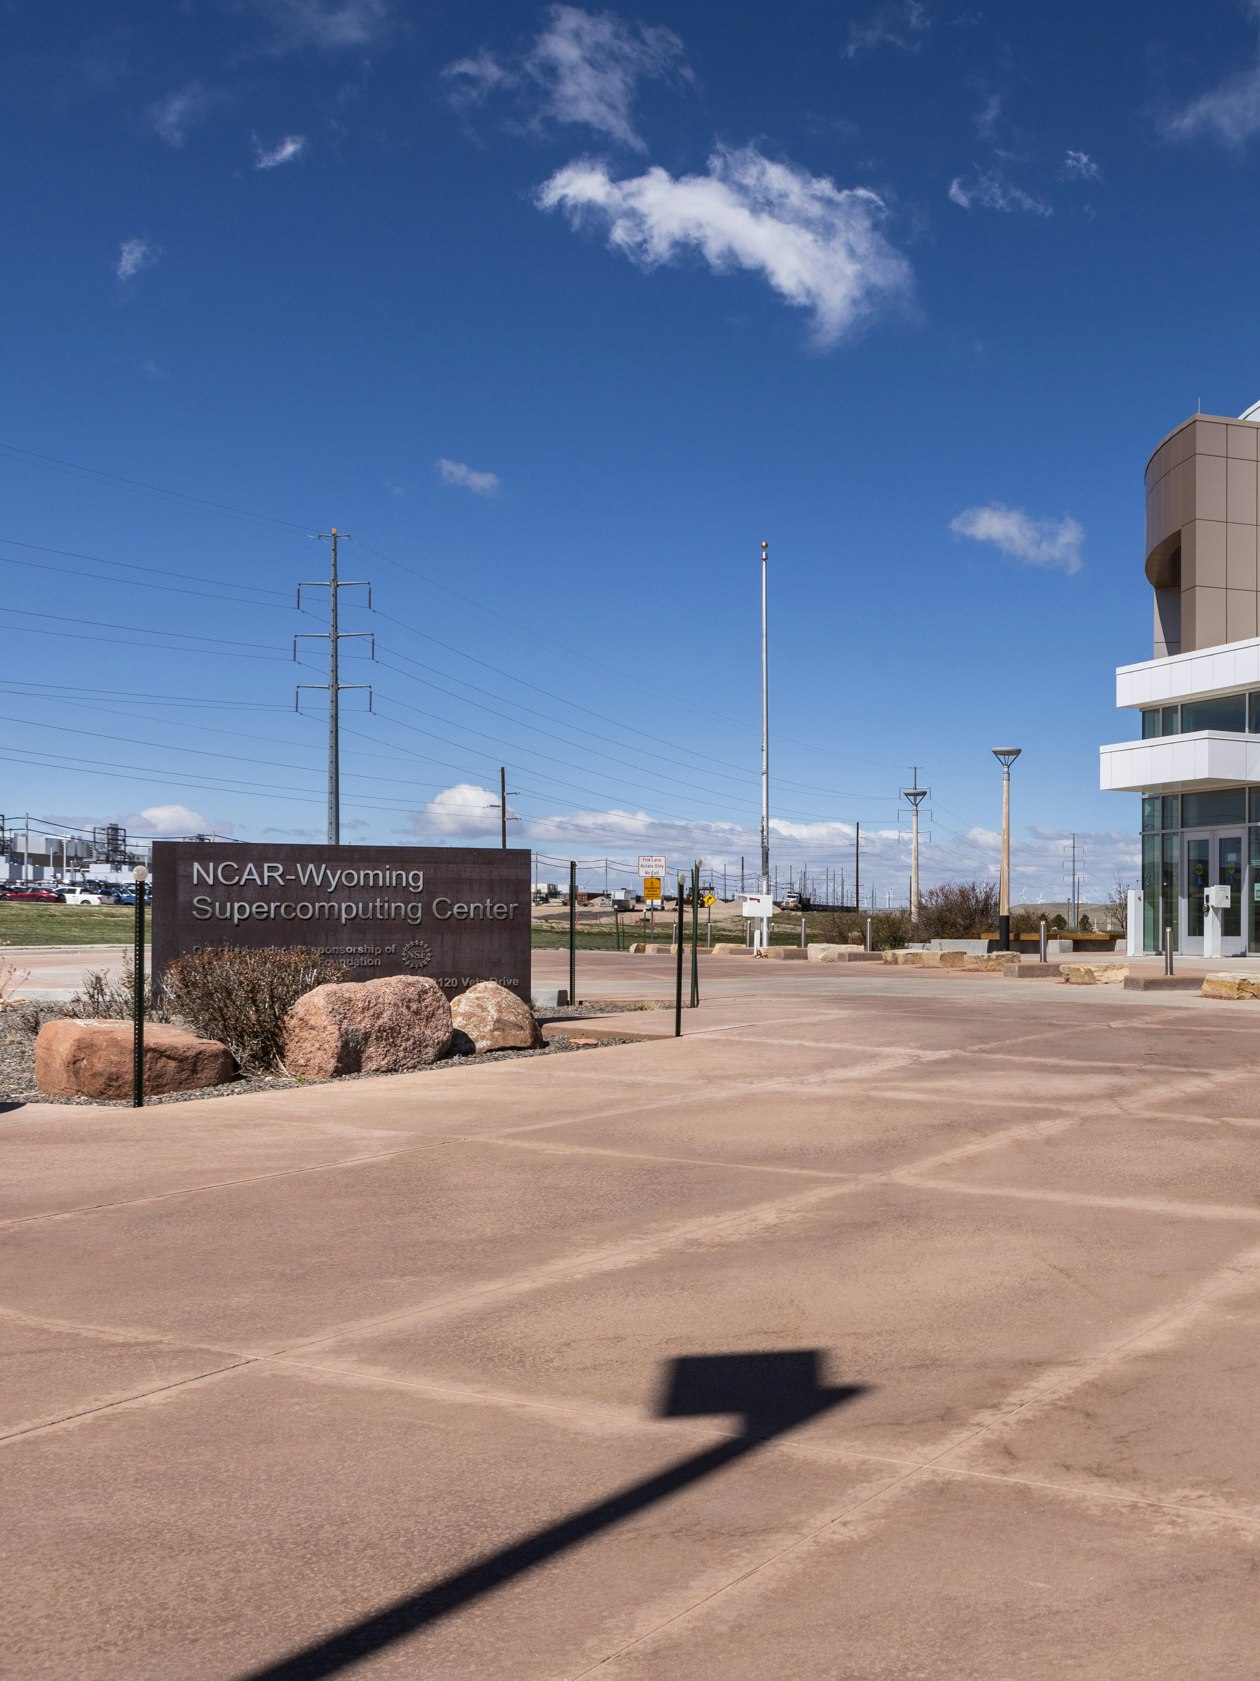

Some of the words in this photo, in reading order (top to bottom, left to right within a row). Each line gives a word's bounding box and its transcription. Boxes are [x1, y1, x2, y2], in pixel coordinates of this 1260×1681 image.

[192, 861, 424, 892] NCAR-Wyoming
[192, 896, 423, 926] Supercomputing
[432, 897, 519, 921] Center
[311, 944, 382, 955] sponsorship
[385, 944, 397, 954] of
[407, 951, 426, 959] NSF
[319, 957, 382, 966] Foundation
